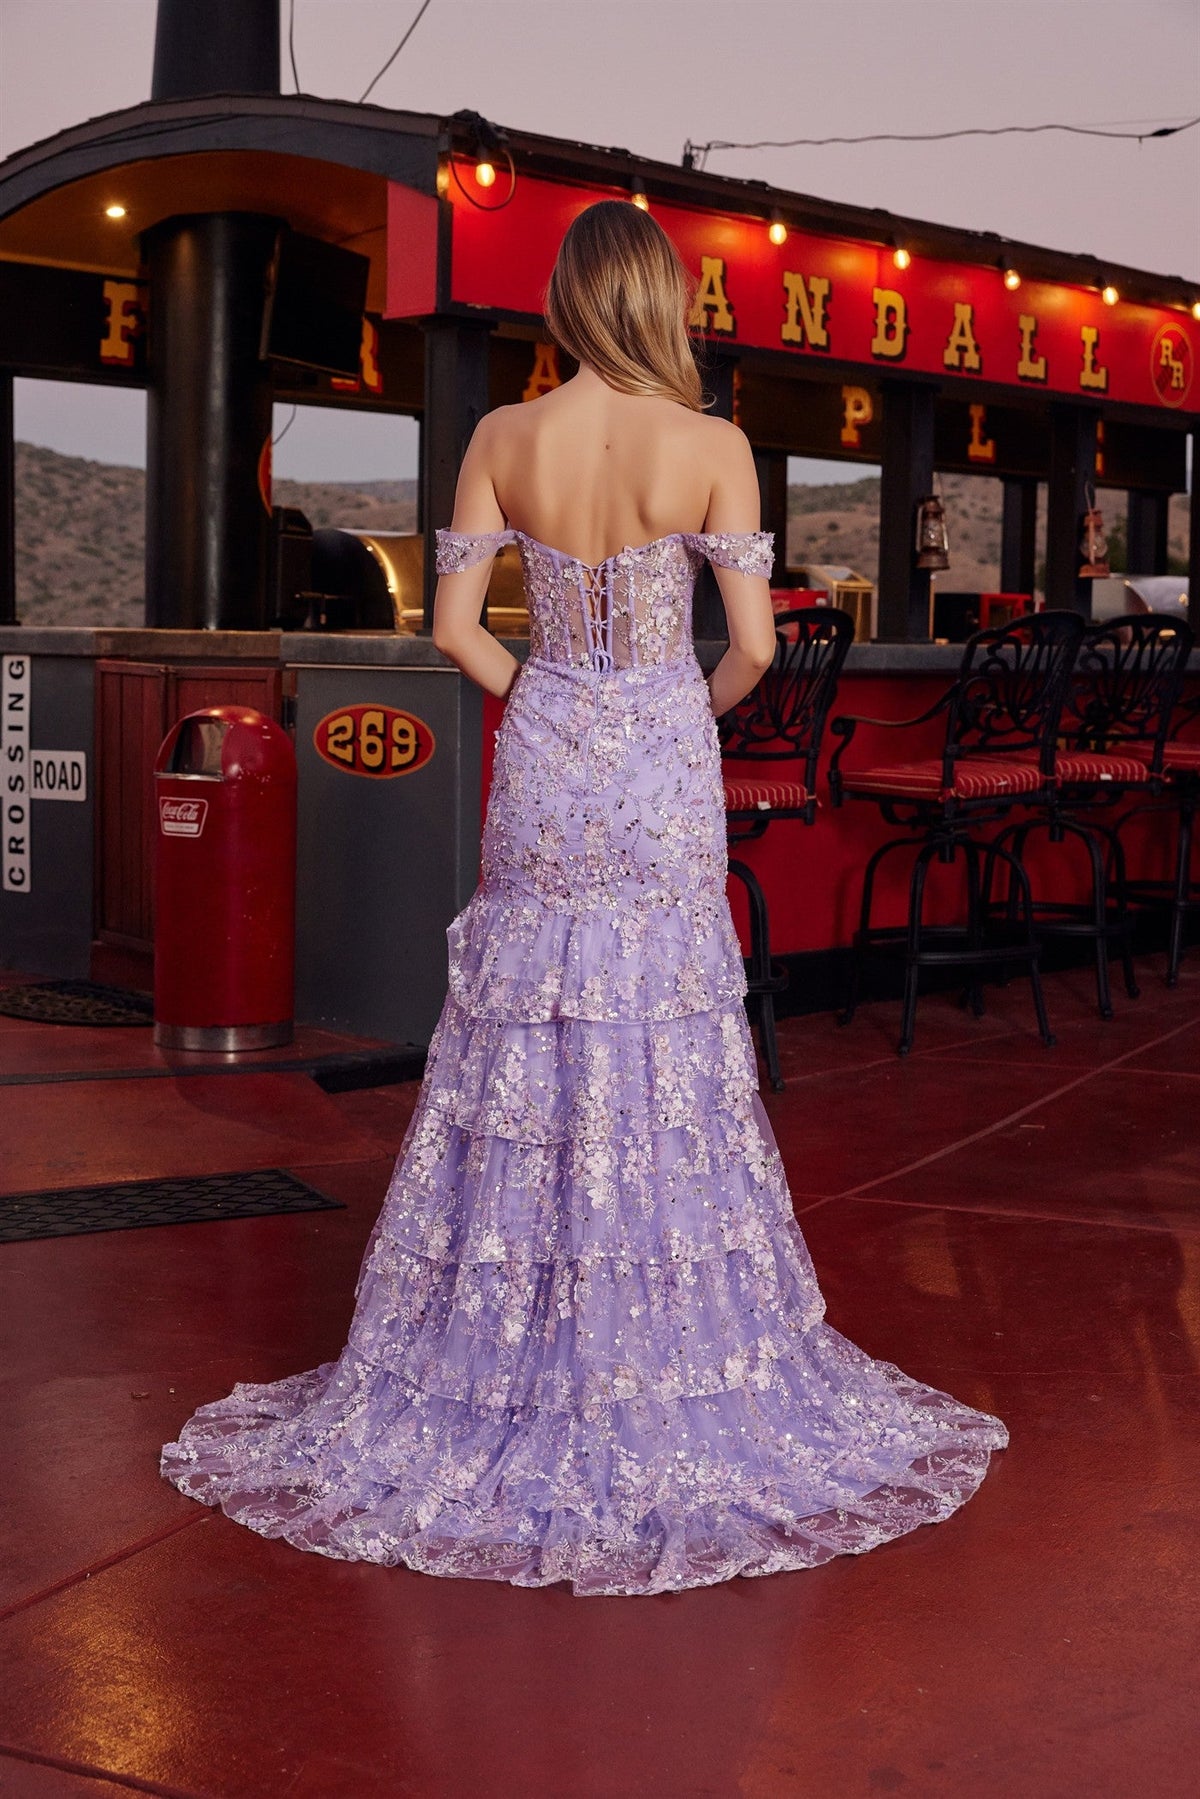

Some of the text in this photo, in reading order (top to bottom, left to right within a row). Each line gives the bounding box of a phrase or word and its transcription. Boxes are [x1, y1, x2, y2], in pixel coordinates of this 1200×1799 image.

[327, 710, 418, 770] 269
[8, 659, 26, 886] CROSSING
[33, 760, 82, 792] ROAD
